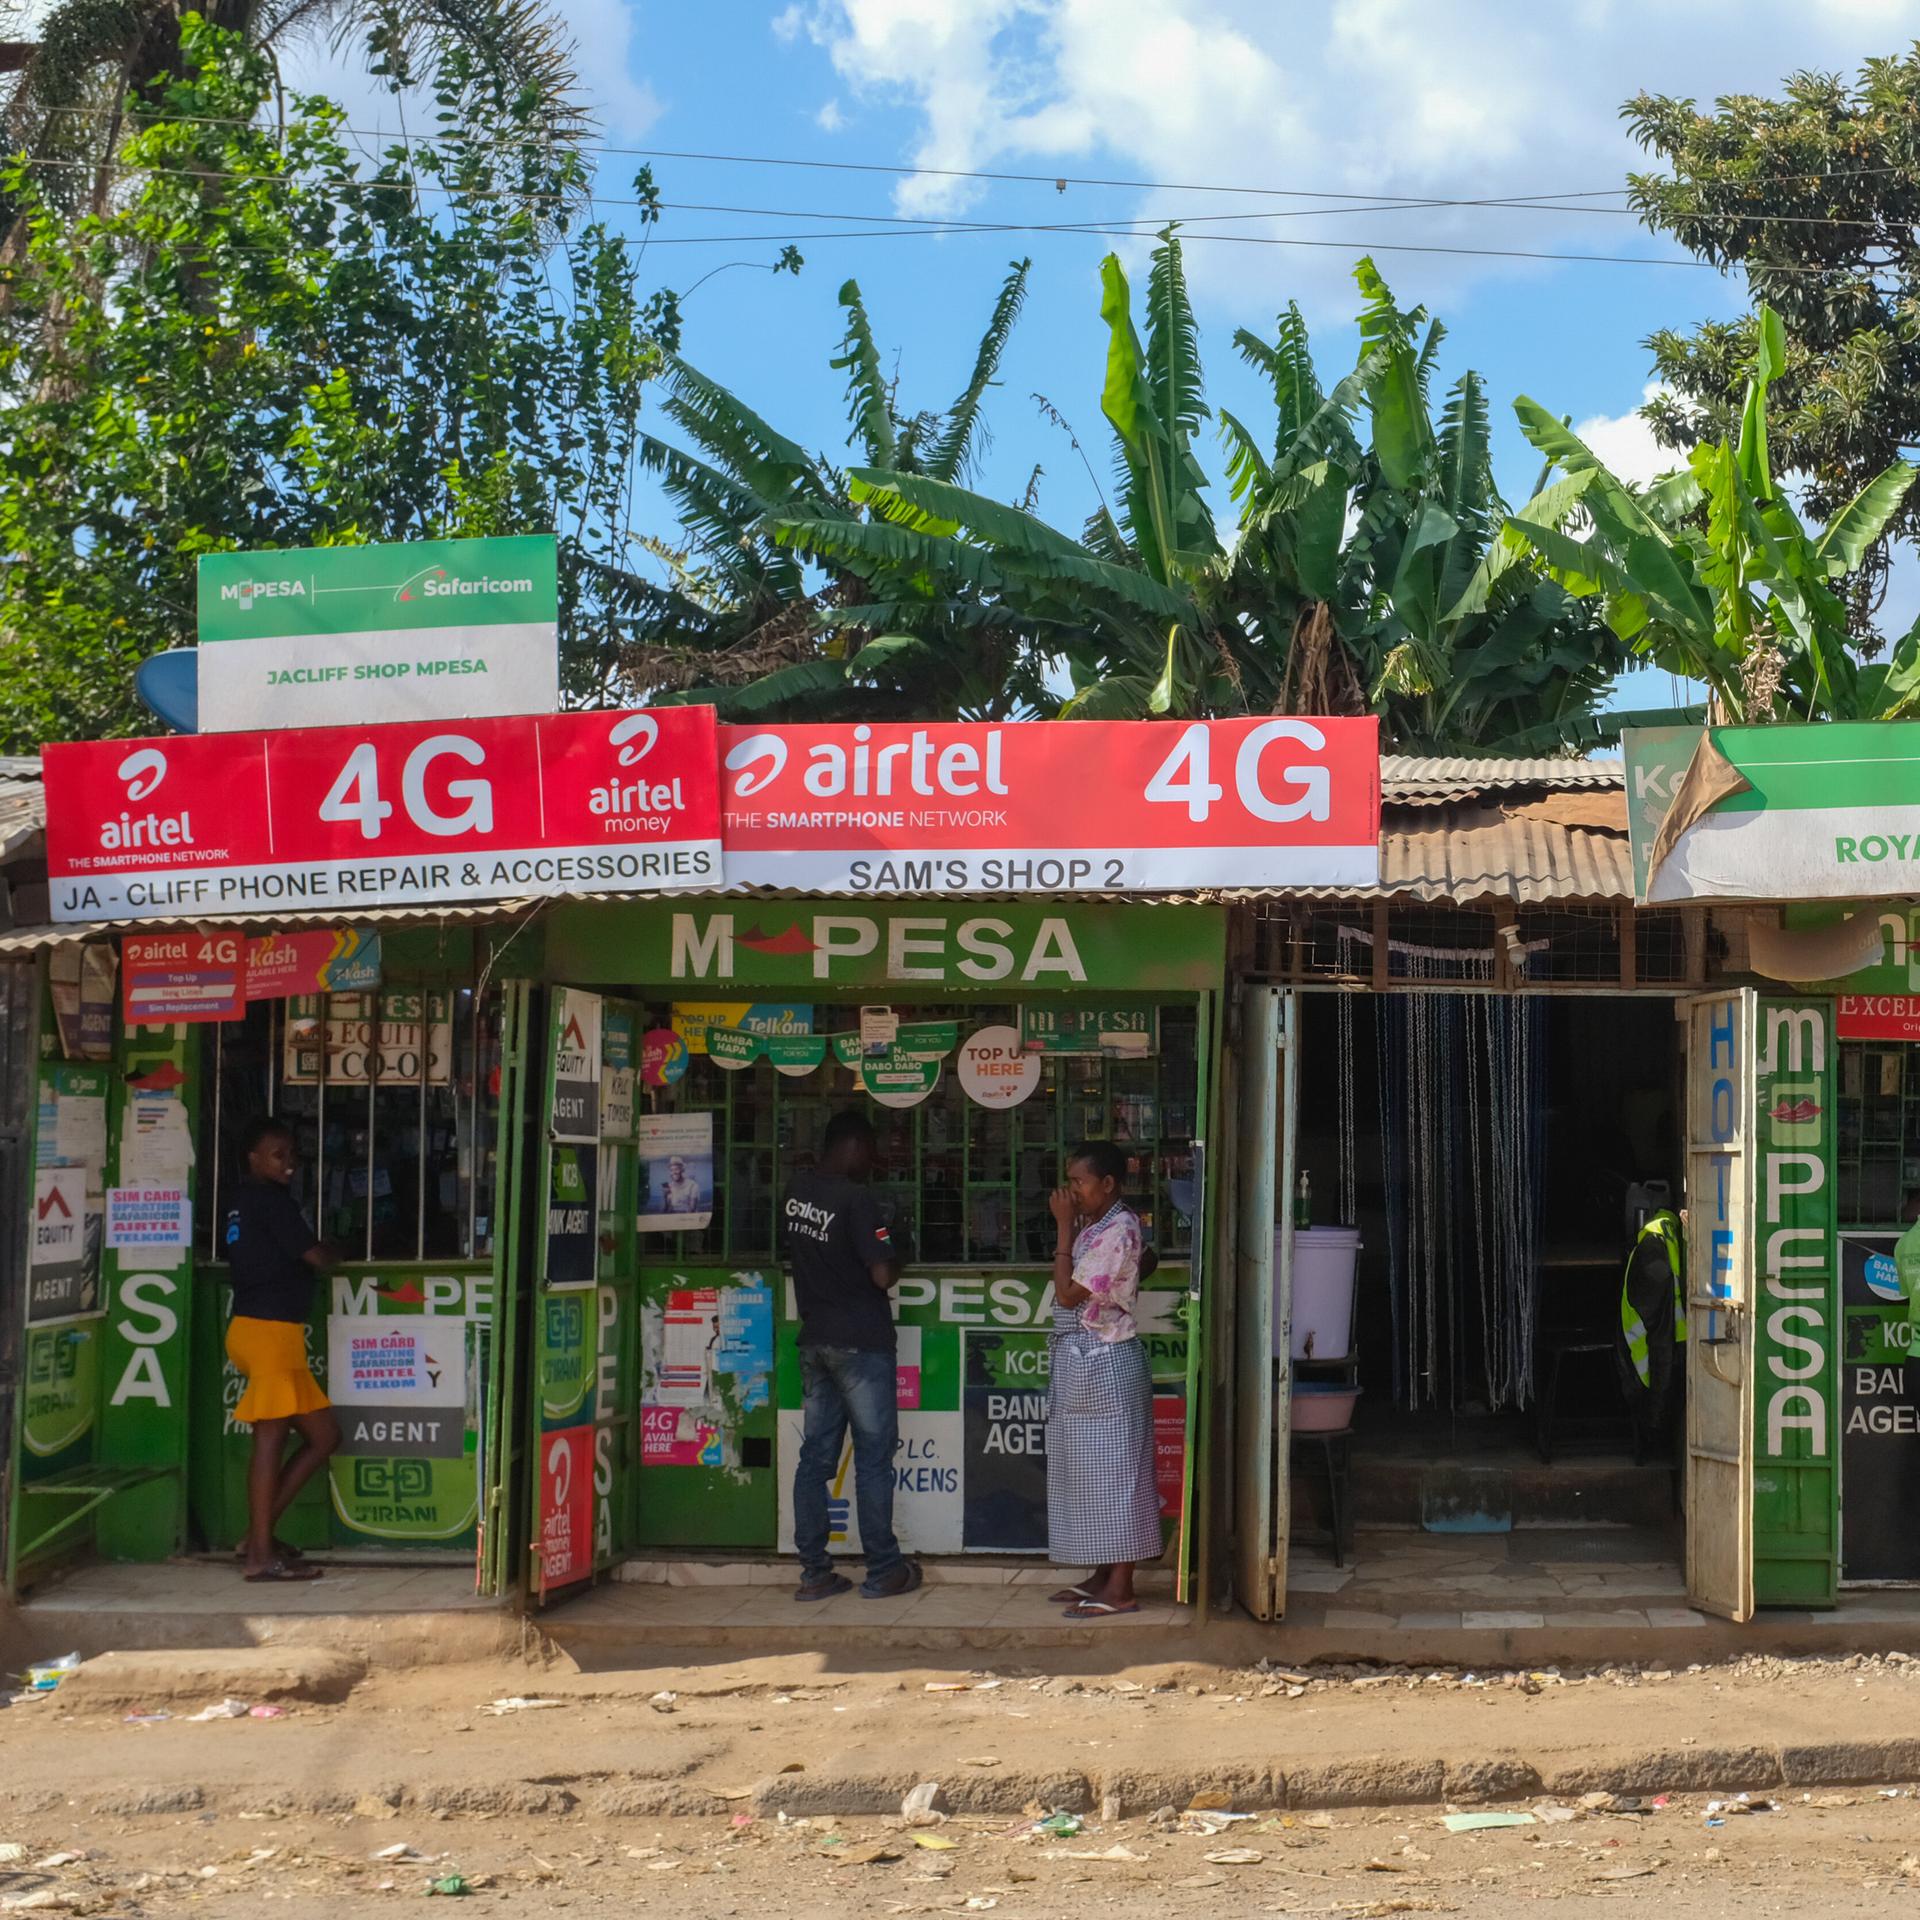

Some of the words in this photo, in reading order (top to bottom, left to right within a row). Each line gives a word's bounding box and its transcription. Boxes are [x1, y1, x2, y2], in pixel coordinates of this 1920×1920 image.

[424, 575, 533, 598] Safaricom
[267, 666, 348, 686] JACLIFF
[354, 662, 410, 680] SHOP
[416, 658, 488, 677] MPESA
[803, 725, 1008, 798] airtel
[1144, 720, 1331, 823] 4G
[318, 734, 494, 839] 4G
[589, 777, 685, 815] airtel
[604, 816, 672, 834] money
[724, 812, 762, 828] THE
[766, 811, 904, 827] SMARTPHONE
[909, 810, 1006, 827] NETWORK
[100, 811, 194, 850] airtel
[68, 857, 90, 868] THE
[93, 851, 171, 867] SMARTPHONE
[173, 848, 229, 862] NETWORK
[63, 887, 102, 911] JA
[126, 879, 209, 906] CLIFF
[219, 871, 328, 900] PHONE
[338, 864, 450, 894] REPAIR
[460, 862, 482, 886] &
[490, 849, 711, 882] ACCESSORIES
[849, 860, 974, 890] SAM'S
[981, 858, 1091, 888] SHOP
[1104, 858, 1124, 887] 2
[144, 942, 187, 960] airtel
[197, 940, 238, 964] 4G
[168, 974, 184, 984] Top
[187, 973, 197, 983] Up
[149, 1003, 164, 1013] Sim
[165, 1001, 220, 1013] Replacement
[708, 1015, 727, 1025] UP
[747, 1017, 809, 1034] Telkom
[713, 1032, 754, 1048] BAMBA
[716, 1042, 747, 1056] HAPA
[967, 1048, 1004, 1061] TOP
[1009, 1048, 1026, 1061] U
[864, 1062, 893, 1072] DABO
[894, 1061, 922, 1071] DABO
[976, 1063, 1024, 1077] HERE
[607, 1103, 631, 1123] TOKENS
[113, 1191, 139, 1202] SIM
[143, 1190, 180, 1202] CARD
[112, 1203, 180, 1211] UPDATING
[785, 1198, 835, 1233] Galaxy
[112, 1212, 180, 1221] SAFARICOM
[565, 1209, 589, 1234] AGENT
[113, 1221, 180, 1231] AIRTEL
[37, 1225, 73, 1246] EQUITY
[113, 1232, 179, 1242] TELKOM
[1875, 1271, 1899, 1283] HAP
[34, 1277, 73, 1302] AGENT
[352, 1338, 377, 1350] SIM
[381, 1336, 415, 1349] CARD
[352, 1349, 415, 1359] UPDATING
[352, 1358, 415, 1368] SAFARICOM
[353, 1368, 416, 1378] AIRTEL
[354, 1379, 416, 1389] TELKOM
[897, 1388, 914, 1398] ERE
[644, 1411, 673, 1431] 4G
[354, 1421, 441, 1442] AGENT
[644, 1443, 673, 1453] HERE
[544, 1503, 571, 1538] airtel
[544, 1552, 573, 1578] AGENT
